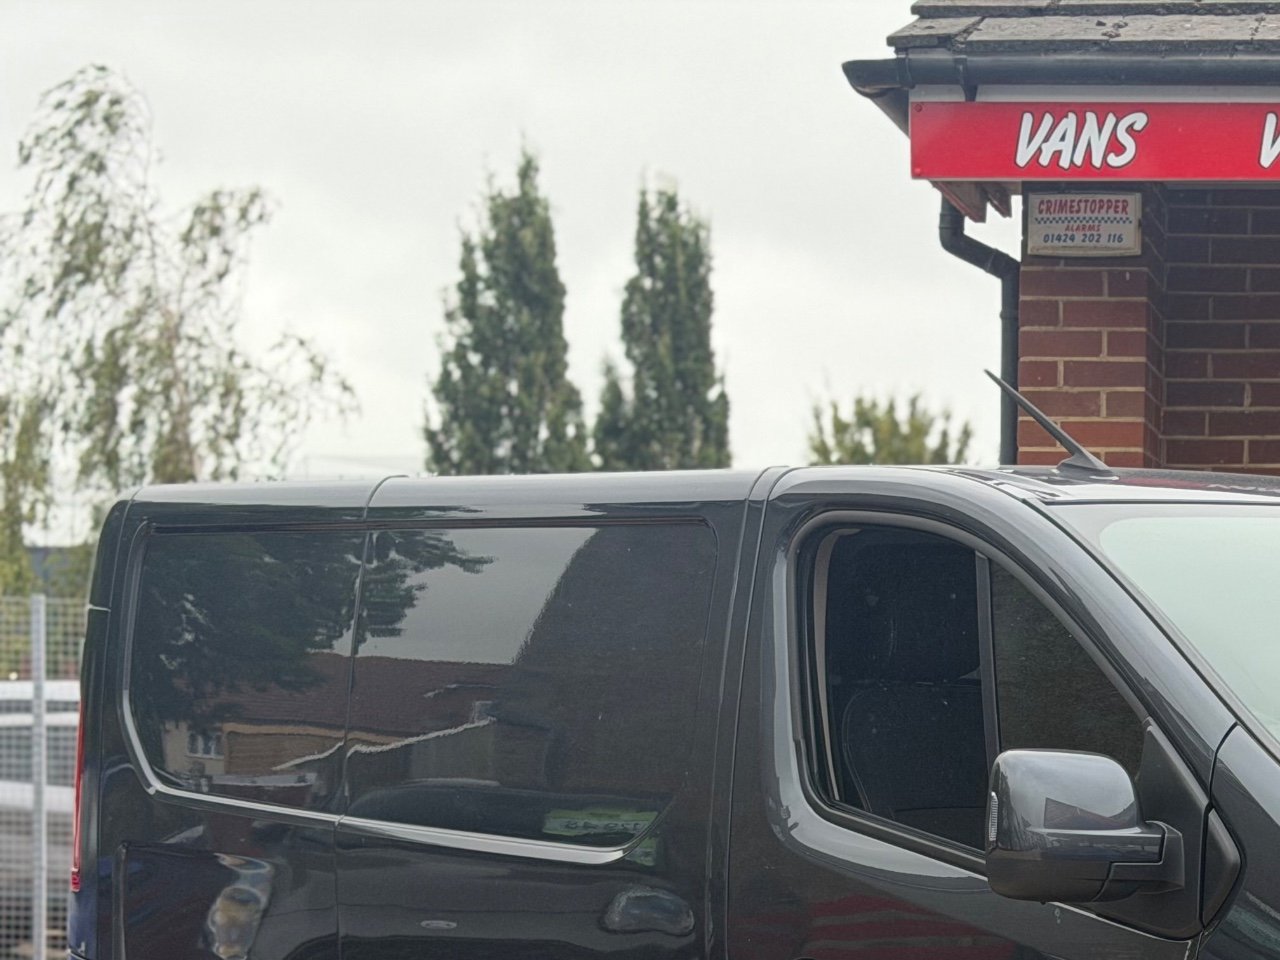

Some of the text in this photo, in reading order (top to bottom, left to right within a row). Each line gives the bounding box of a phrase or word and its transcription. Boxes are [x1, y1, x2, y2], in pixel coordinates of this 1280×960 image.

[1014, 110, 1148, 169] VANS
[1038, 199, 1129, 215] CRIMESTOPPER
[1064, 224, 1102, 232] ALARMS
[1043, 233, 1123, 243] 01424 202 116
